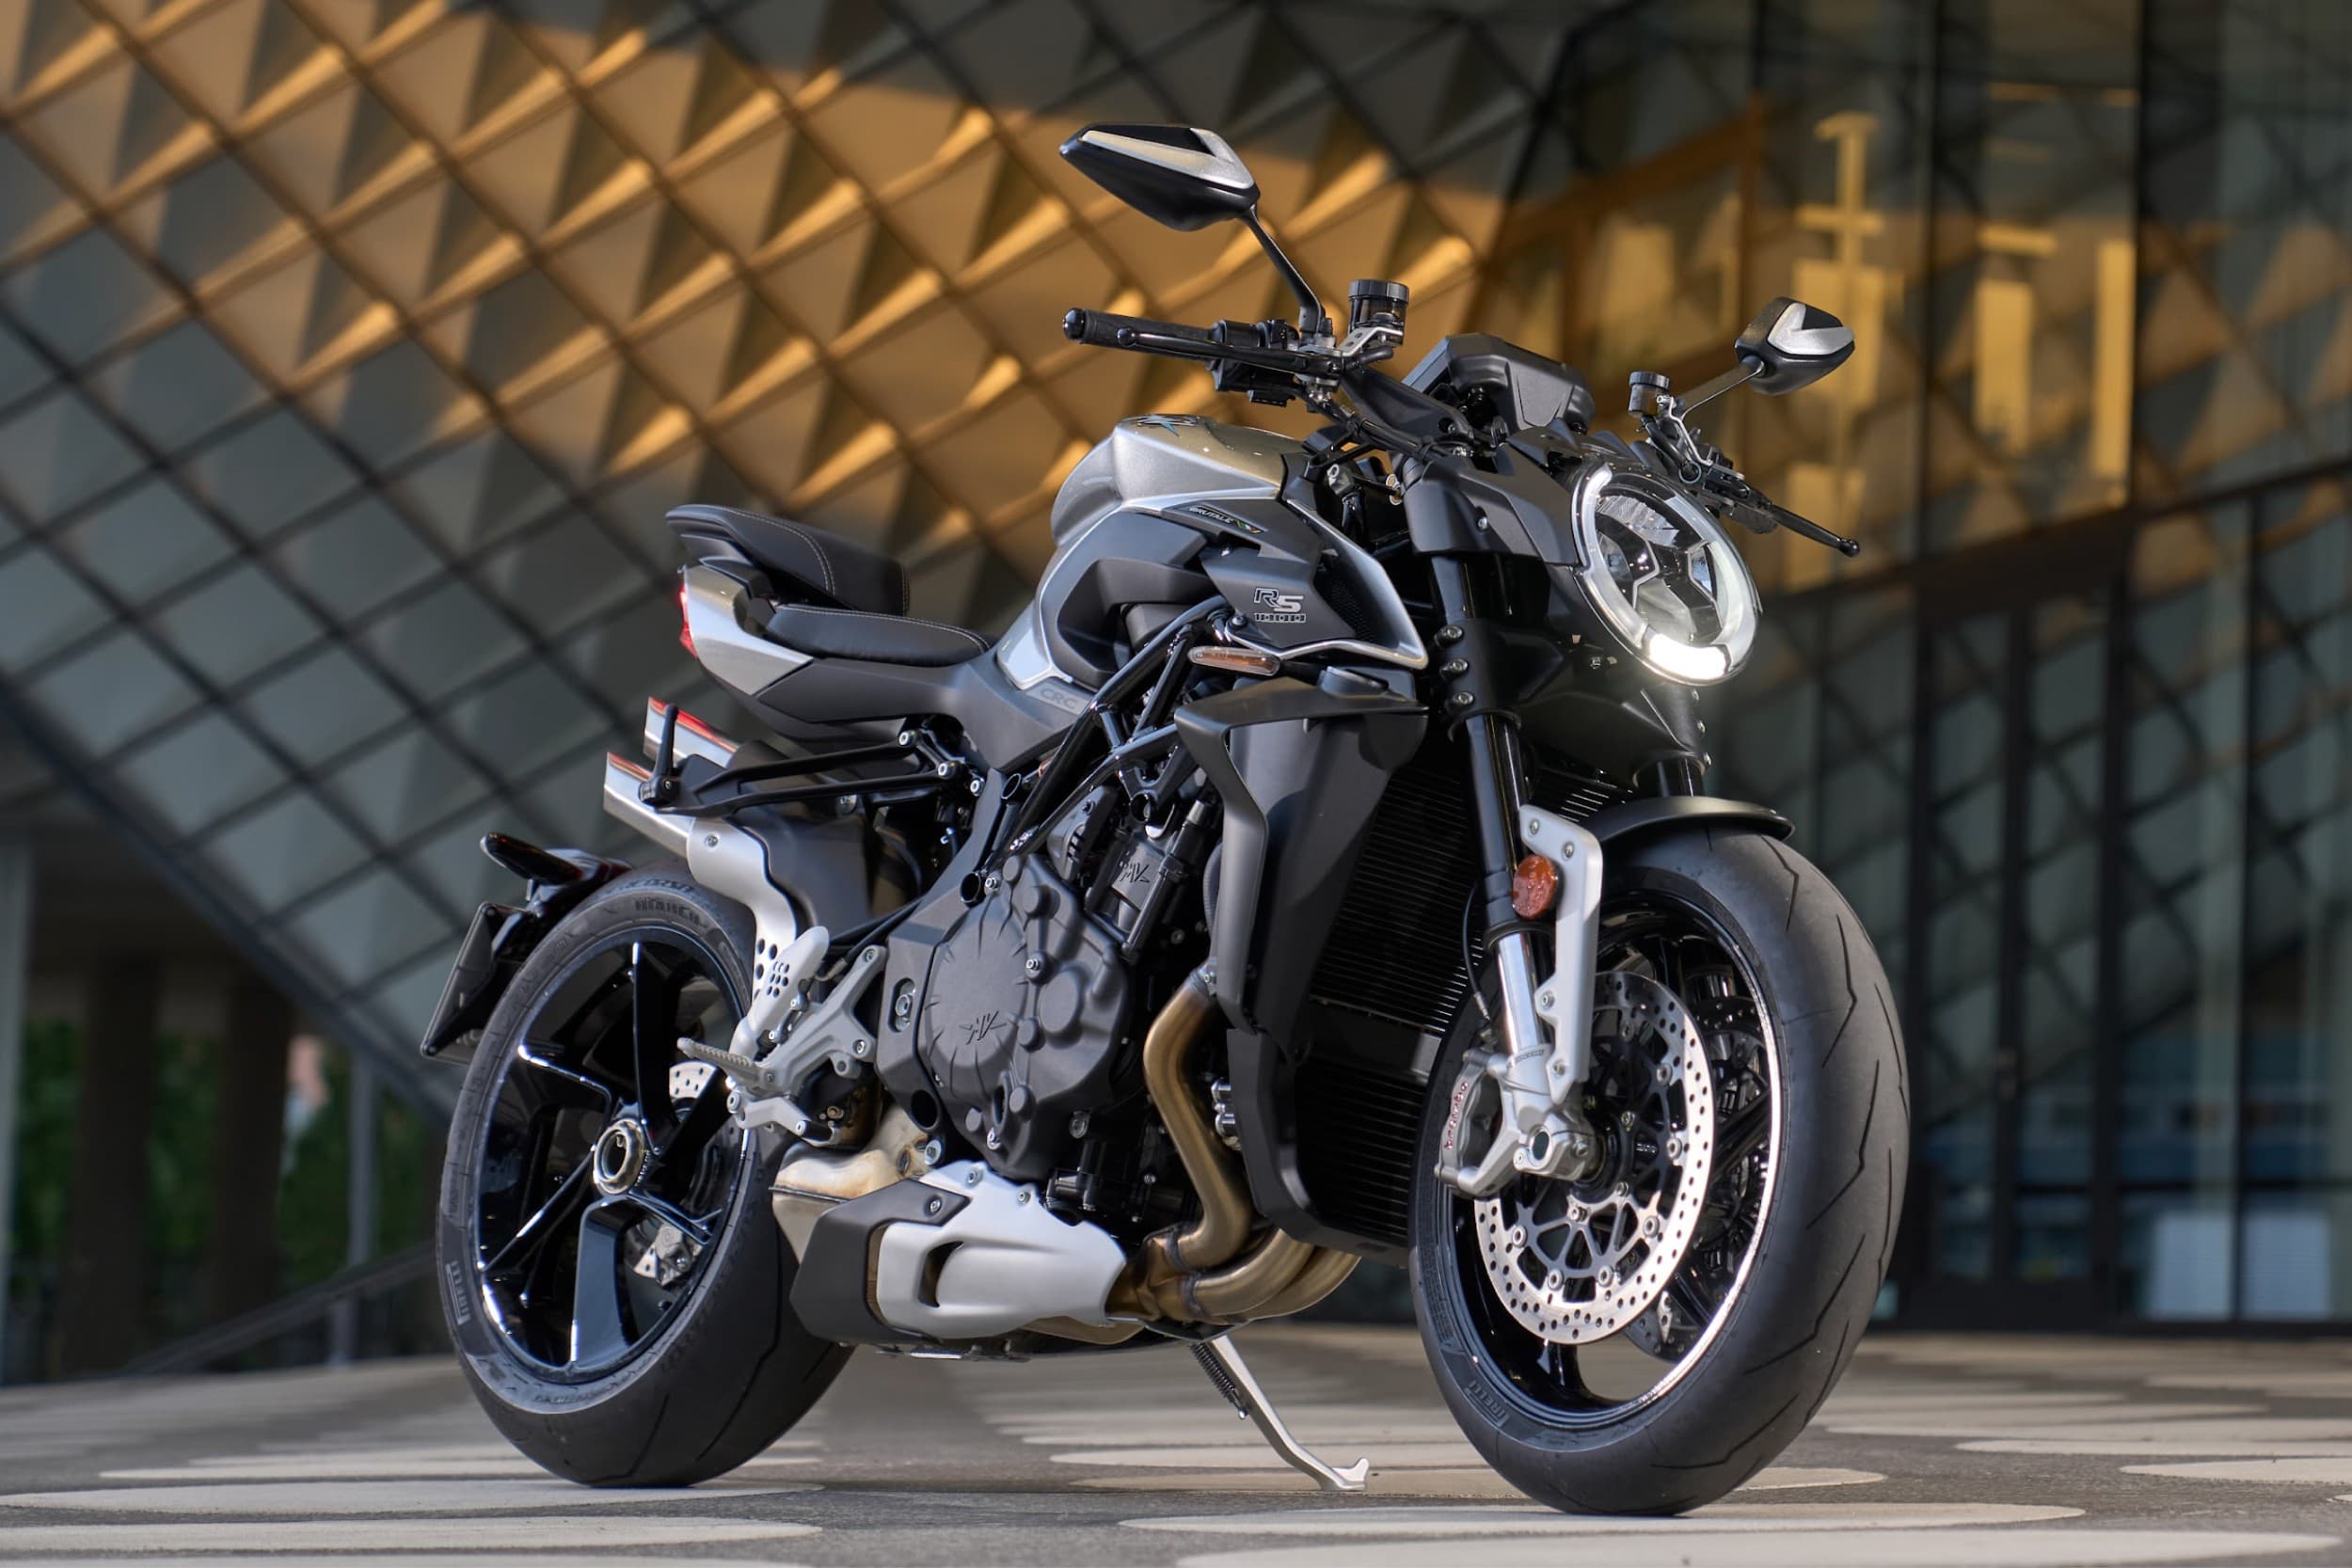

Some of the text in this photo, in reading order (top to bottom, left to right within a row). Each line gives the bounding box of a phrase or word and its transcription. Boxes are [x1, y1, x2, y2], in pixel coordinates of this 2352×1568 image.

[1254, 588, 1304, 612] RS
[1041, 689, 1079, 709] CRC
[1444, 1082, 1468, 1149] brembo
[1465, 1380, 1510, 1428] PIRELLI
